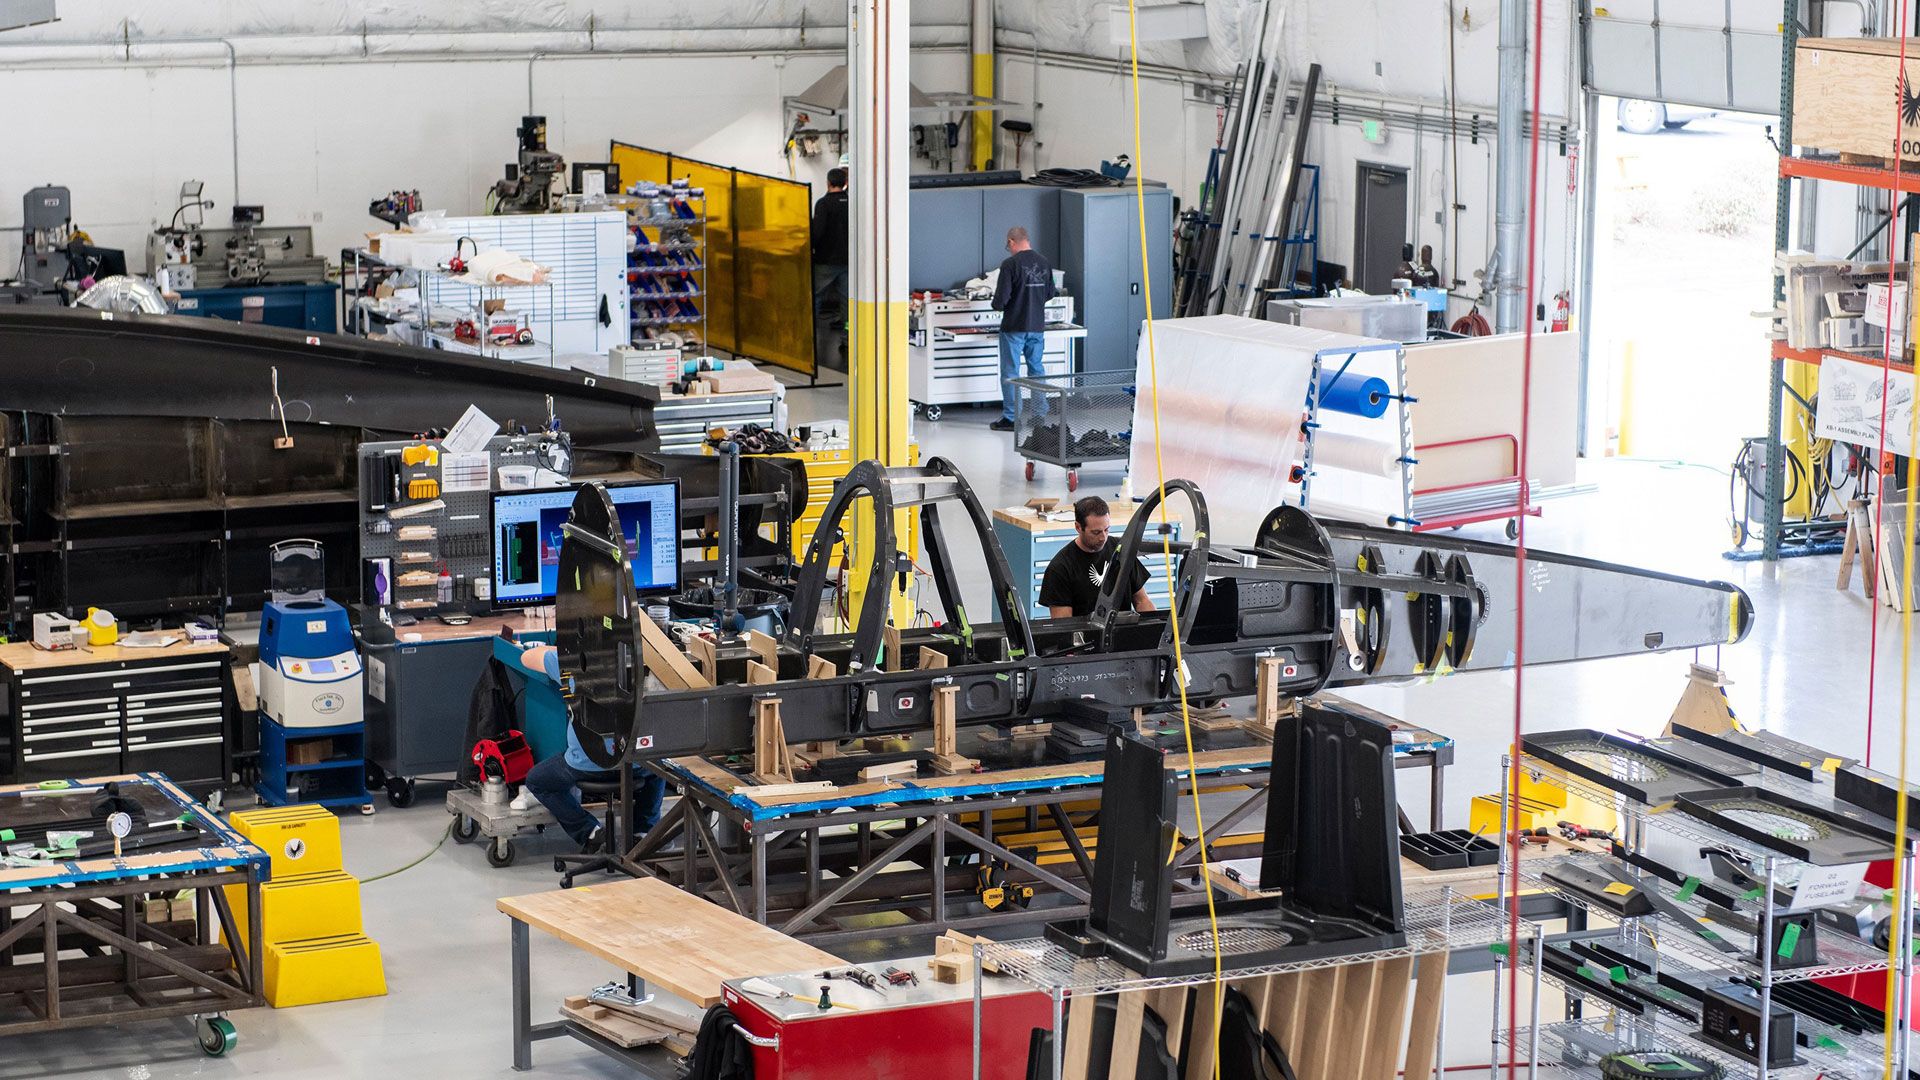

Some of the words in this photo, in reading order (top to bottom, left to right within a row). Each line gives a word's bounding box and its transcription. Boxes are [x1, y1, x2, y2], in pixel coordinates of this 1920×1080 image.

[1838, 427, 1861, 437] ASSEMBLY
[1862, 431, 1875, 440] PLAN
[1808, 880, 1848, 891] FORWARD
[1805, 889, 1845, 899] FUSELAGE
